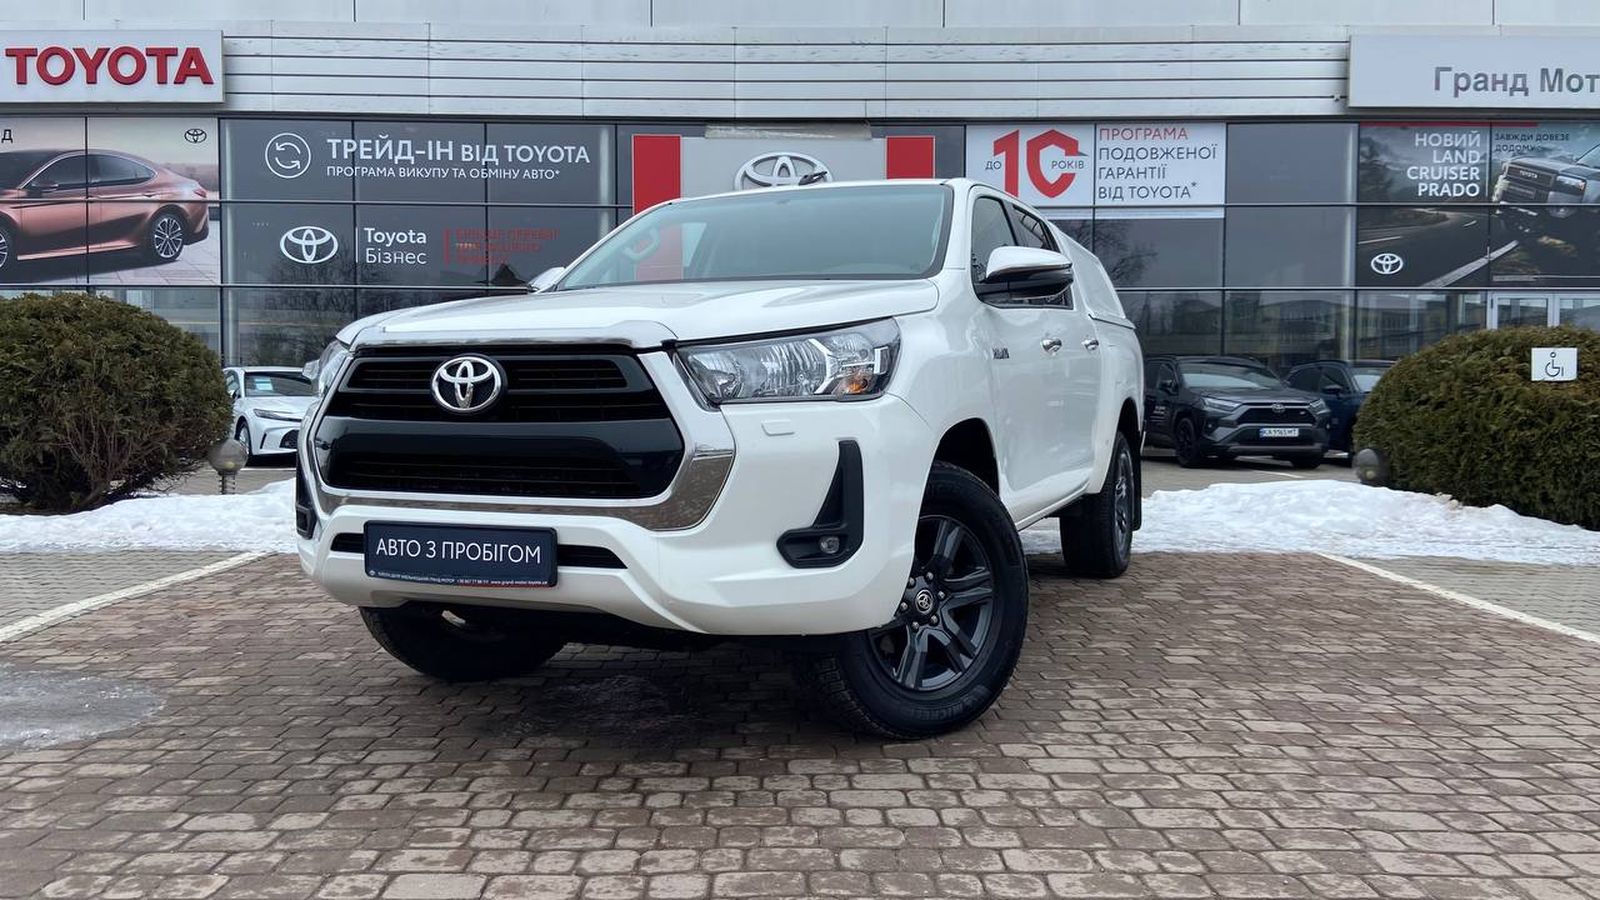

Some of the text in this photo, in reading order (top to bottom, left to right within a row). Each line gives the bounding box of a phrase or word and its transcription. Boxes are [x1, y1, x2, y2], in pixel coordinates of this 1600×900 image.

[5, 46, 214, 86] TOYOTA
[1434, 66, 1600, 98] Гранд Мот
[1099, 128, 1189, 141] ПРОГРАМА
[1415, 131, 1481, 147] НОВИЙ
[1494, 133, 1570, 142] ЗАВЖДИ ДОВЕЗЕ
[327, 134, 591, 165] ТРЕЙД-ІН ВІД TOYOTA
[1099, 144, 1218, 162] ПОДОВЖЕНОЇ
[1433, 150, 1481, 164] LAND
[326, 166, 396, 178] ПРОГРАМА
[398, 167, 450, 179] ВИКУПУ
[452, 168, 467, 179] ТА
[469, 168, 520, 180] ОБМІНУ
[985, 161, 1002, 170] ДО
[1051, 160, 1085, 170] РОКІВ
[1099, 163, 1167, 180] ГАРАНТІЇ
[1406, 166, 1481, 181] CRUISER
[1098, 186, 1124, 201] ВІД
[1418, 183, 1480, 197] PRADO
[364, 227, 427, 247] Toyota
[366, 248, 428, 264] Бізнес
[376, 538, 541, 564] АВТО З ПРОБІГОМ
